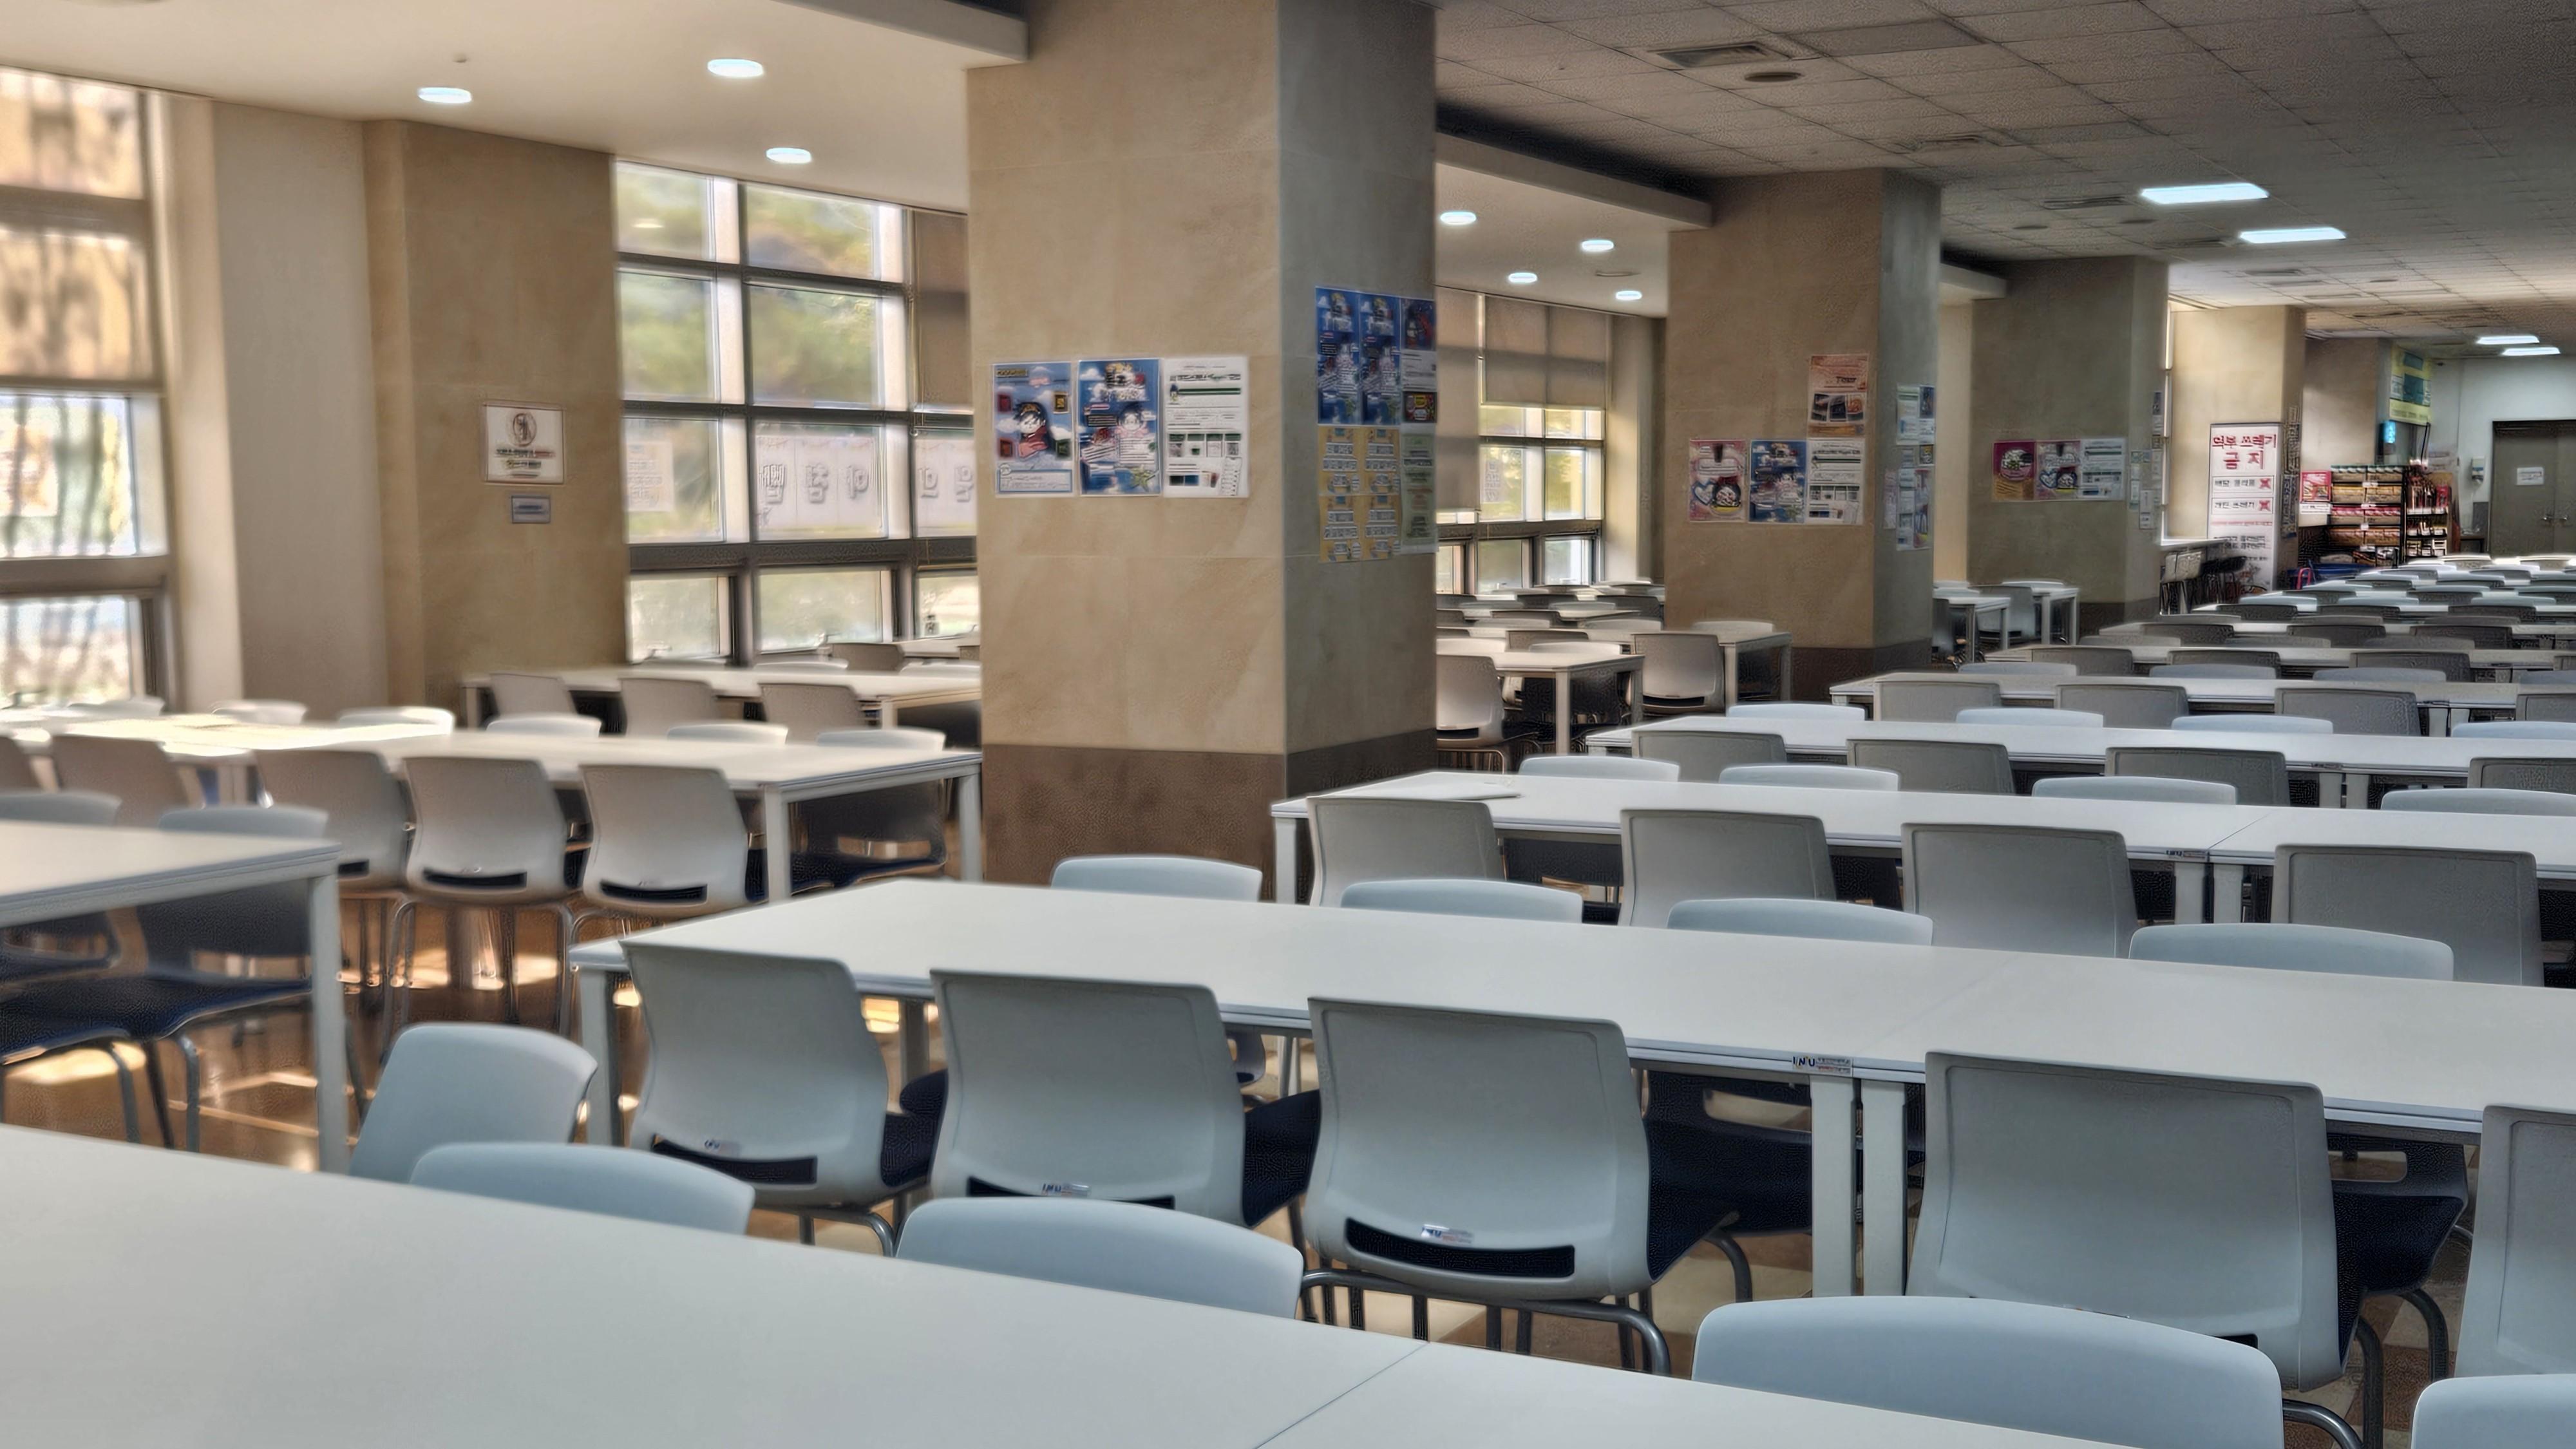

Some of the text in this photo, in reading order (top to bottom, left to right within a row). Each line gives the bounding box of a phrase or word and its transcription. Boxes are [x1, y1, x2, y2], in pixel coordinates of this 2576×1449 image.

[2212, 434, 2277, 449] 외부 쓰레기
[1792, 1056, 1815, 1067] INU
